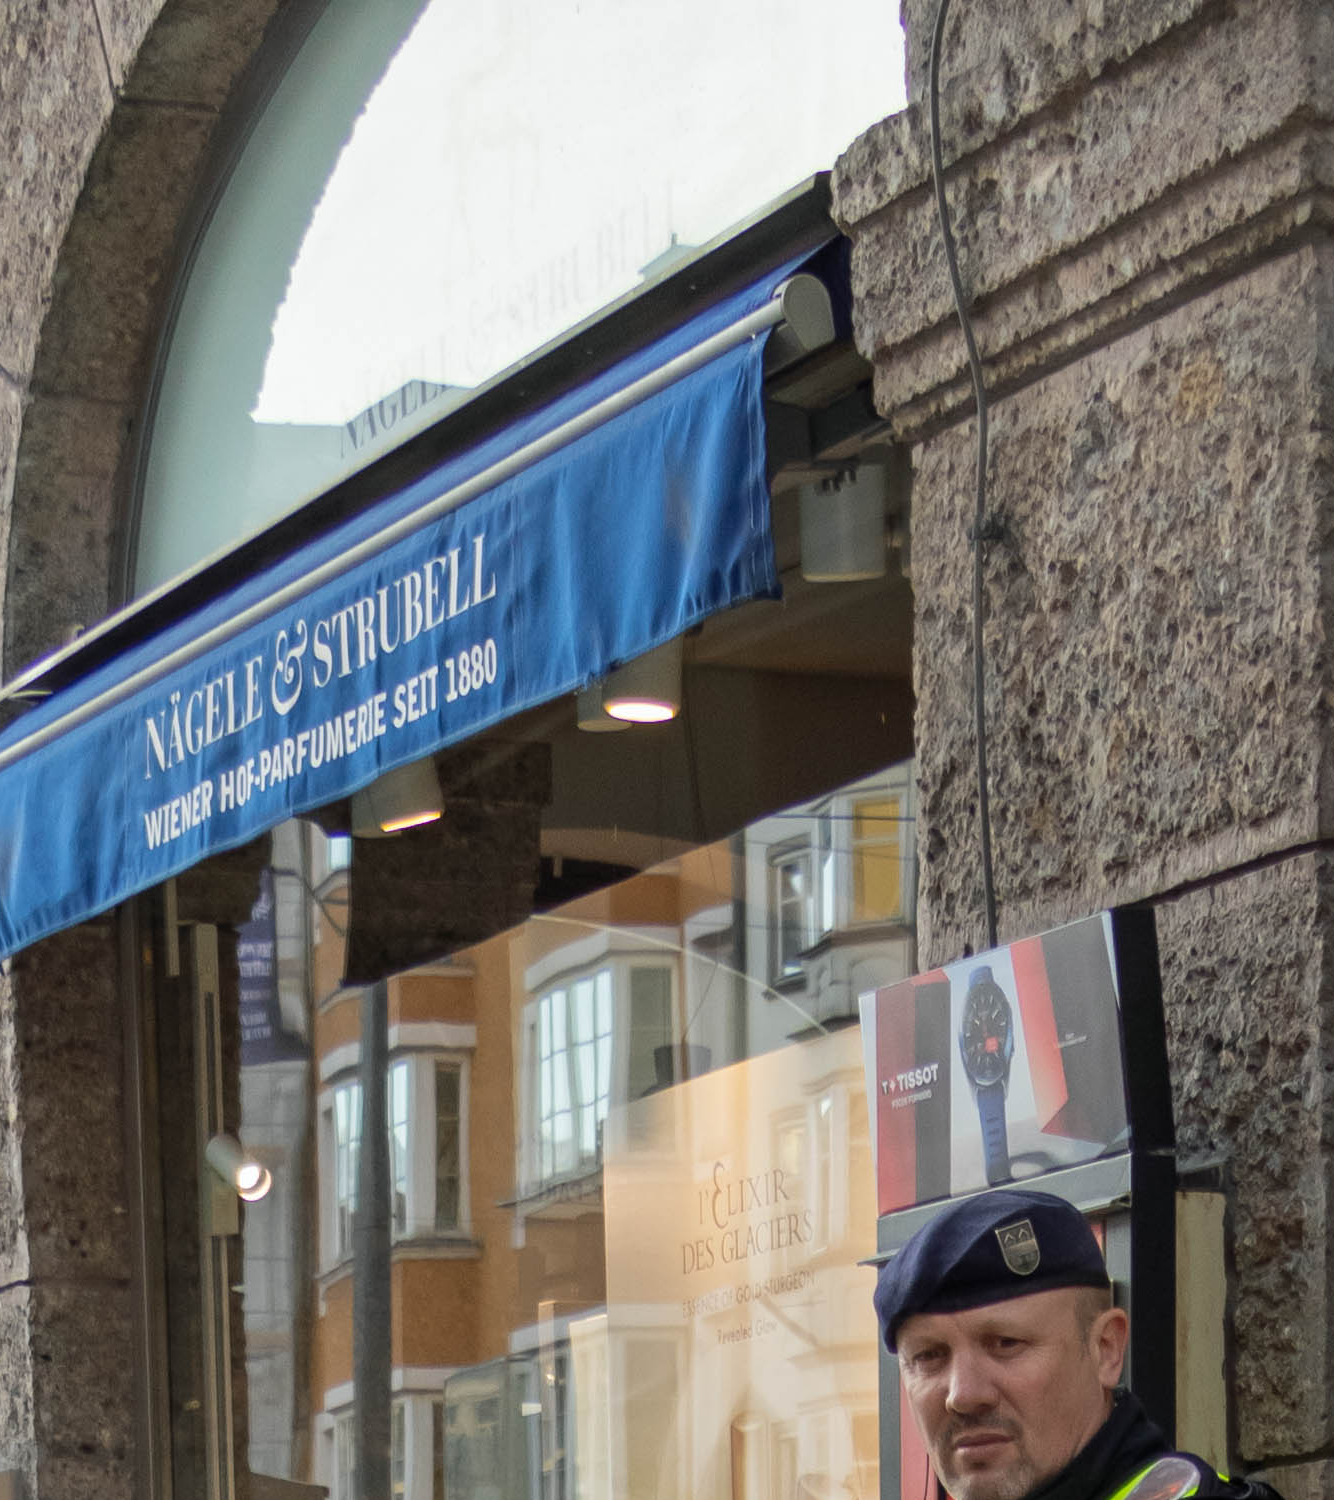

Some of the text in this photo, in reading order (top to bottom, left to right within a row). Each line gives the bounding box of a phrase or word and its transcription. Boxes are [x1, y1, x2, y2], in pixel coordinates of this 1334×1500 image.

[145, 533, 497, 780] NÄGELE & STRUBELL
[144, 638, 498, 851] WIENER HOF-PARFUMERIE SEIT 1880
[896, 1063, 939, 1092] TISSOT
[682, 1210, 814, 1275] DES GLACIERS
